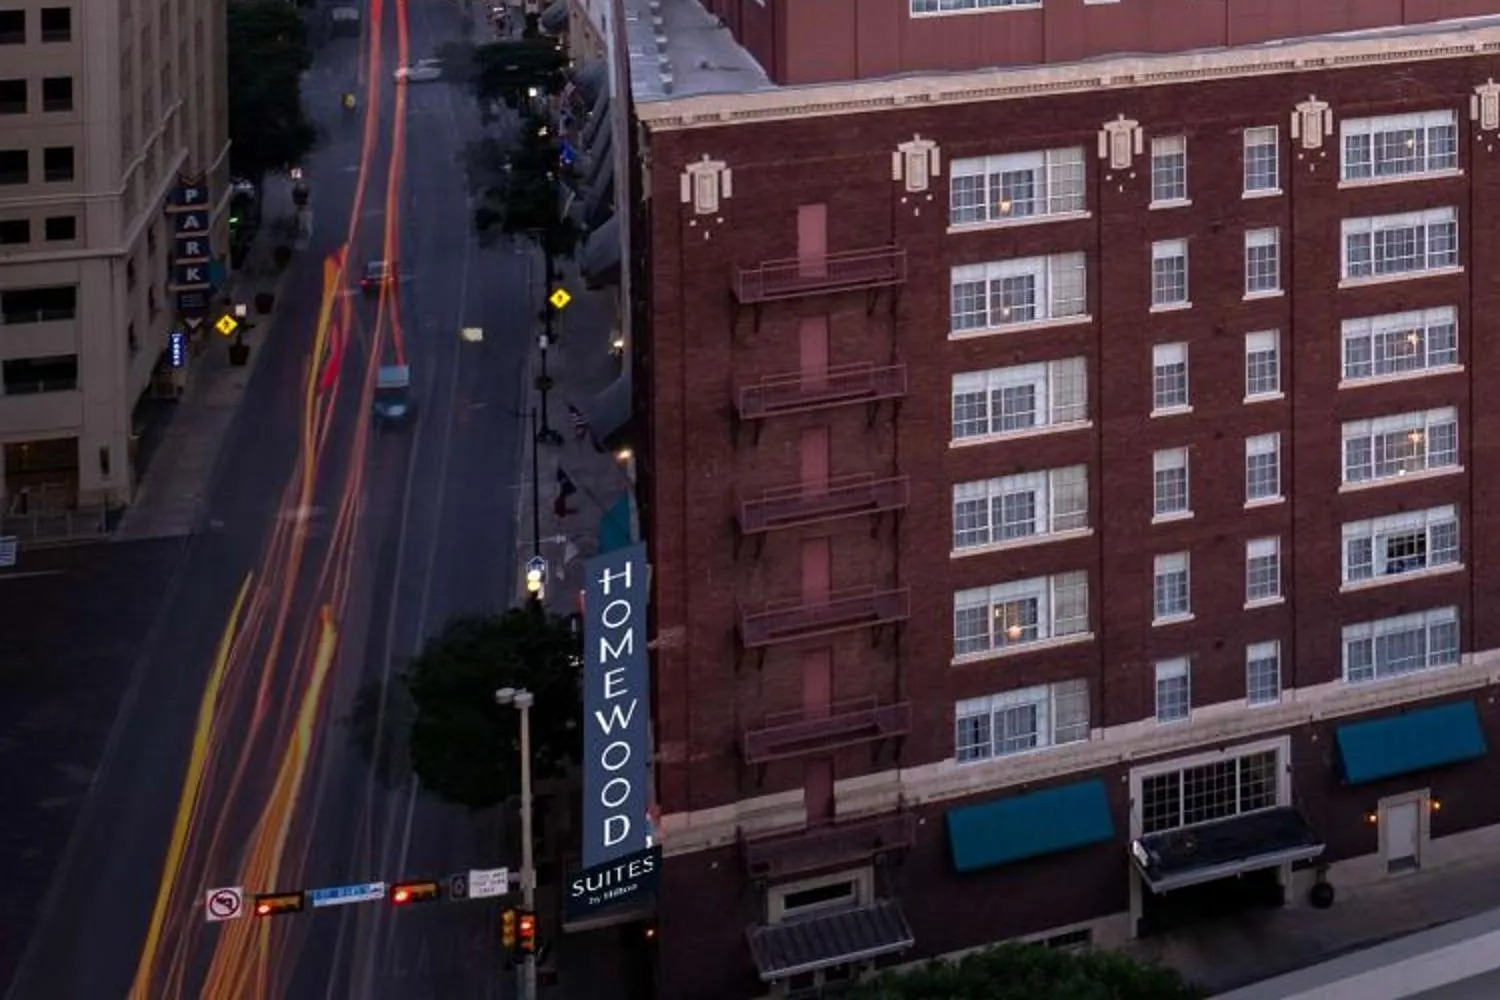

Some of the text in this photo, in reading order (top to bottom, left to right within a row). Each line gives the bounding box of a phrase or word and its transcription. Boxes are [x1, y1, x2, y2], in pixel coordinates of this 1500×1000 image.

[183, 188, 200, 280] PARK
[594, 561, 637, 846] HOMEWOOD
[571, 855, 654, 897] SUITES
